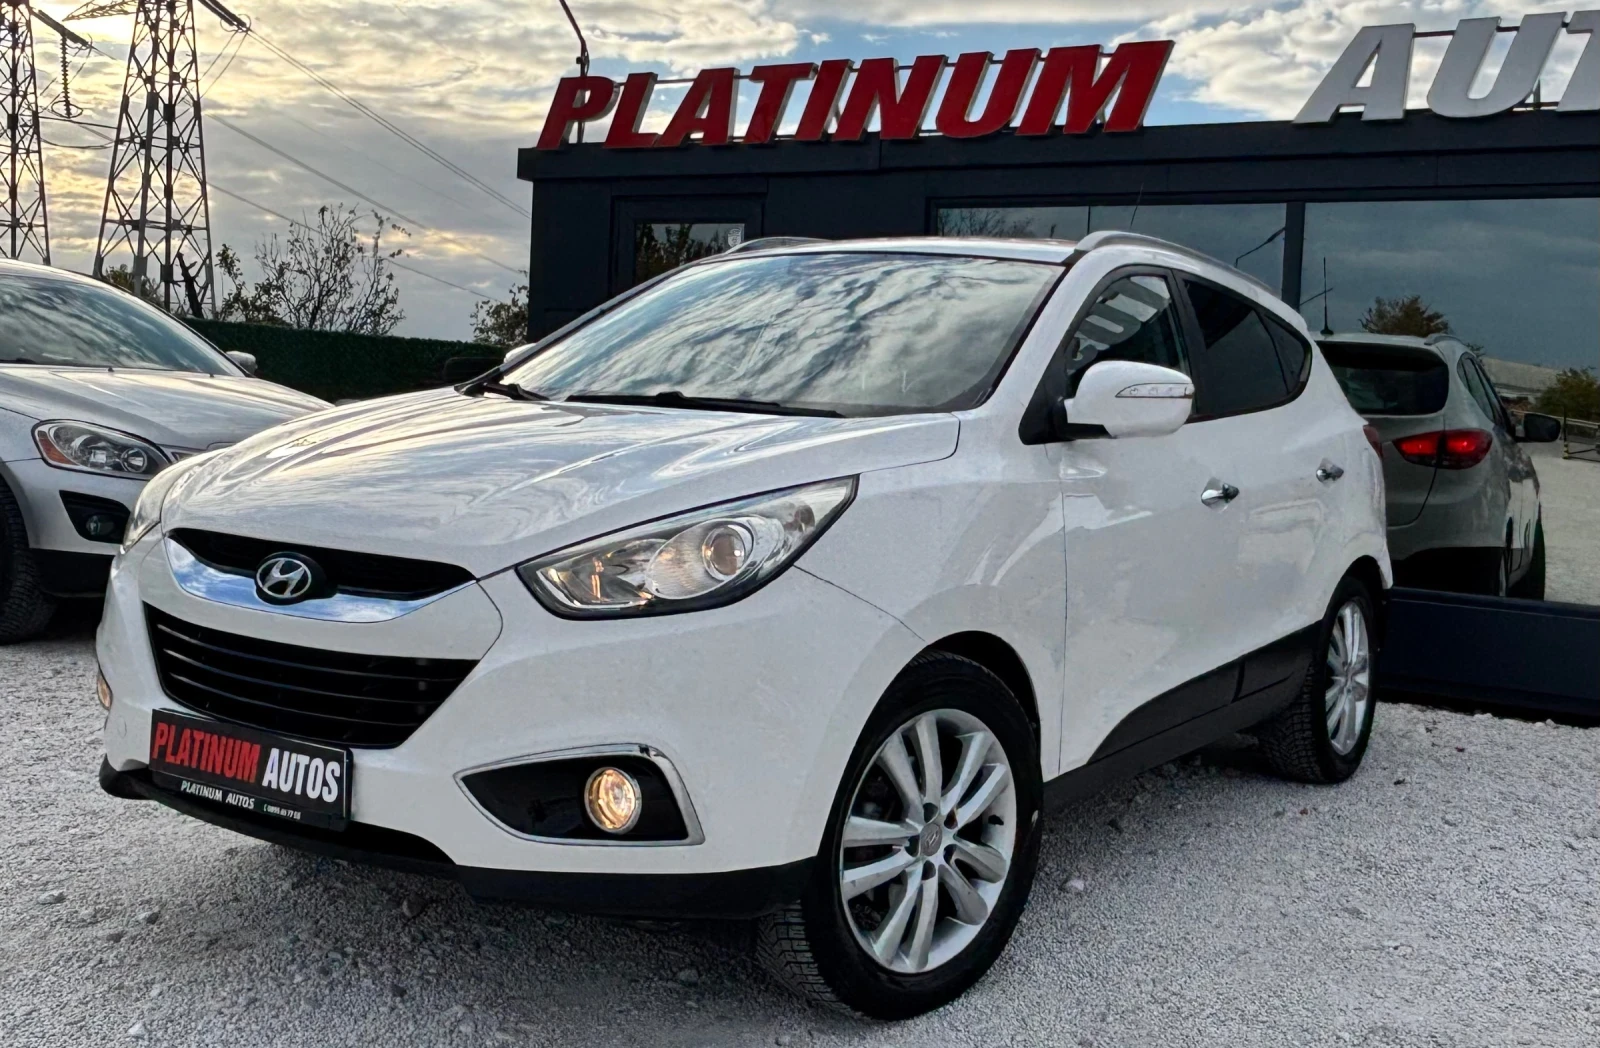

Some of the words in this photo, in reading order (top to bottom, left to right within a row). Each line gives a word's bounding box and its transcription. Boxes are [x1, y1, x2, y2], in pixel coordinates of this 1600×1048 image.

[536, 40, 1175, 149] PLATINUM
[152, 722, 261, 783] PLATINUM
[262, 747, 340, 803] AUTOS
[181, 781, 222, 801] PLATINUM
[226, 793, 255, 809] AUTOS
